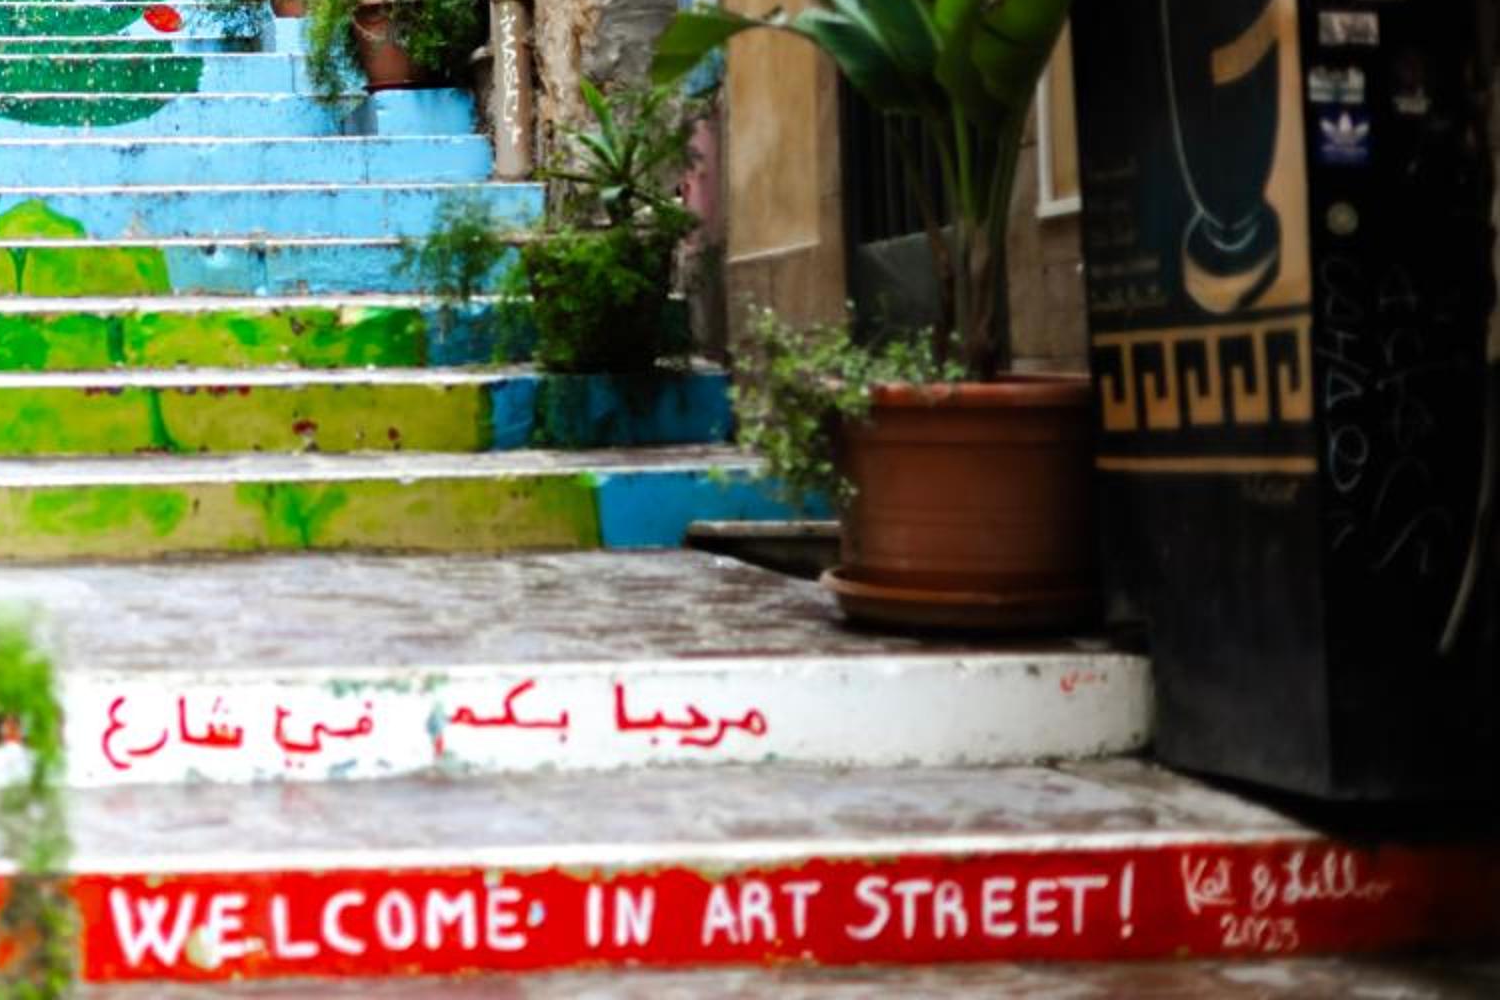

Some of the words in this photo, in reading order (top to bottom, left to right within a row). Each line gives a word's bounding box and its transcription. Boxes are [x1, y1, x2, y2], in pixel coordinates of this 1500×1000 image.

[101, 696, 244, 770] شارع
[273, 701, 374, 769] في
[108, 883, 528, 969] WELCOME
[586, 884, 655, 947] IN
[702, 880, 820, 947] ART
[846, 860, 1135, 941] STREET!
